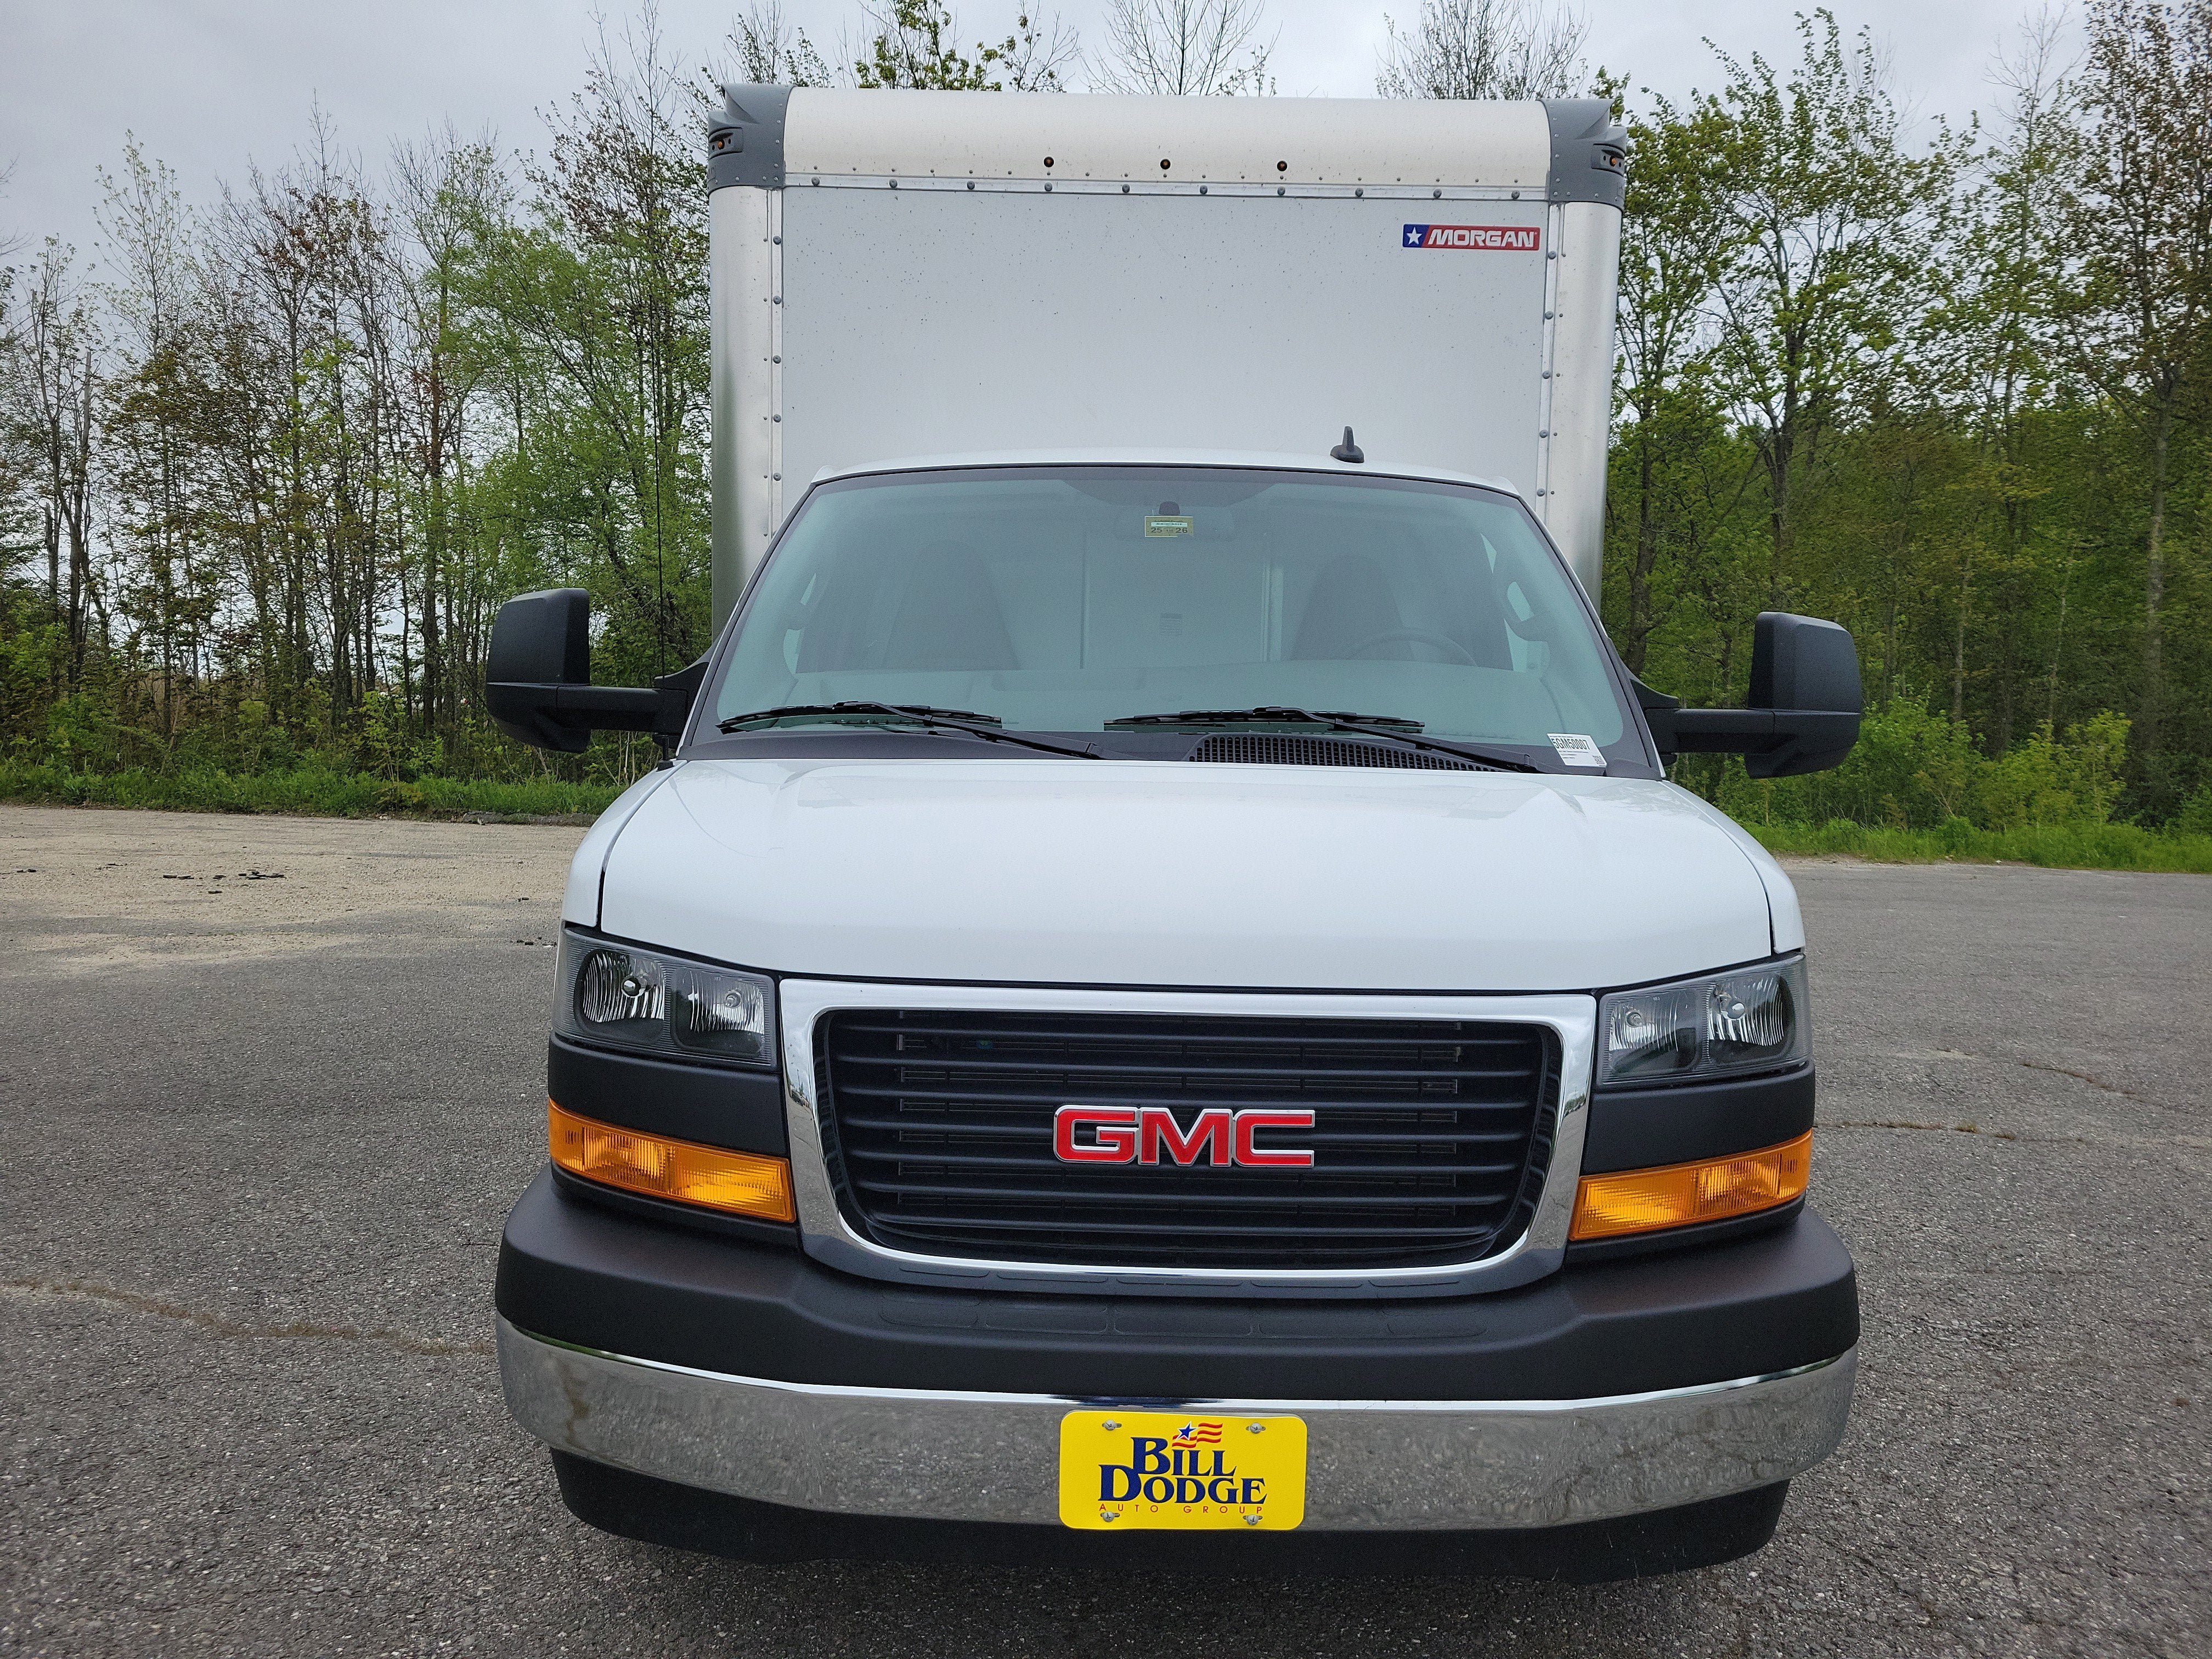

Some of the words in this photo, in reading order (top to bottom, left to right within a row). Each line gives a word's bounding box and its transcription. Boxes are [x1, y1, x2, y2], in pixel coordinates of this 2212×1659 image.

[1428, 229, 1534, 247] MORGAN
[1053, 1105, 1315, 1167] GMC
[1130, 1436, 1237, 1476] BILL
[1098, 1464, 1267, 1504] DODGE
[1099, 1503, 1159, 1513] AUTO
[1183, 1505, 1262, 1514] GROUP
